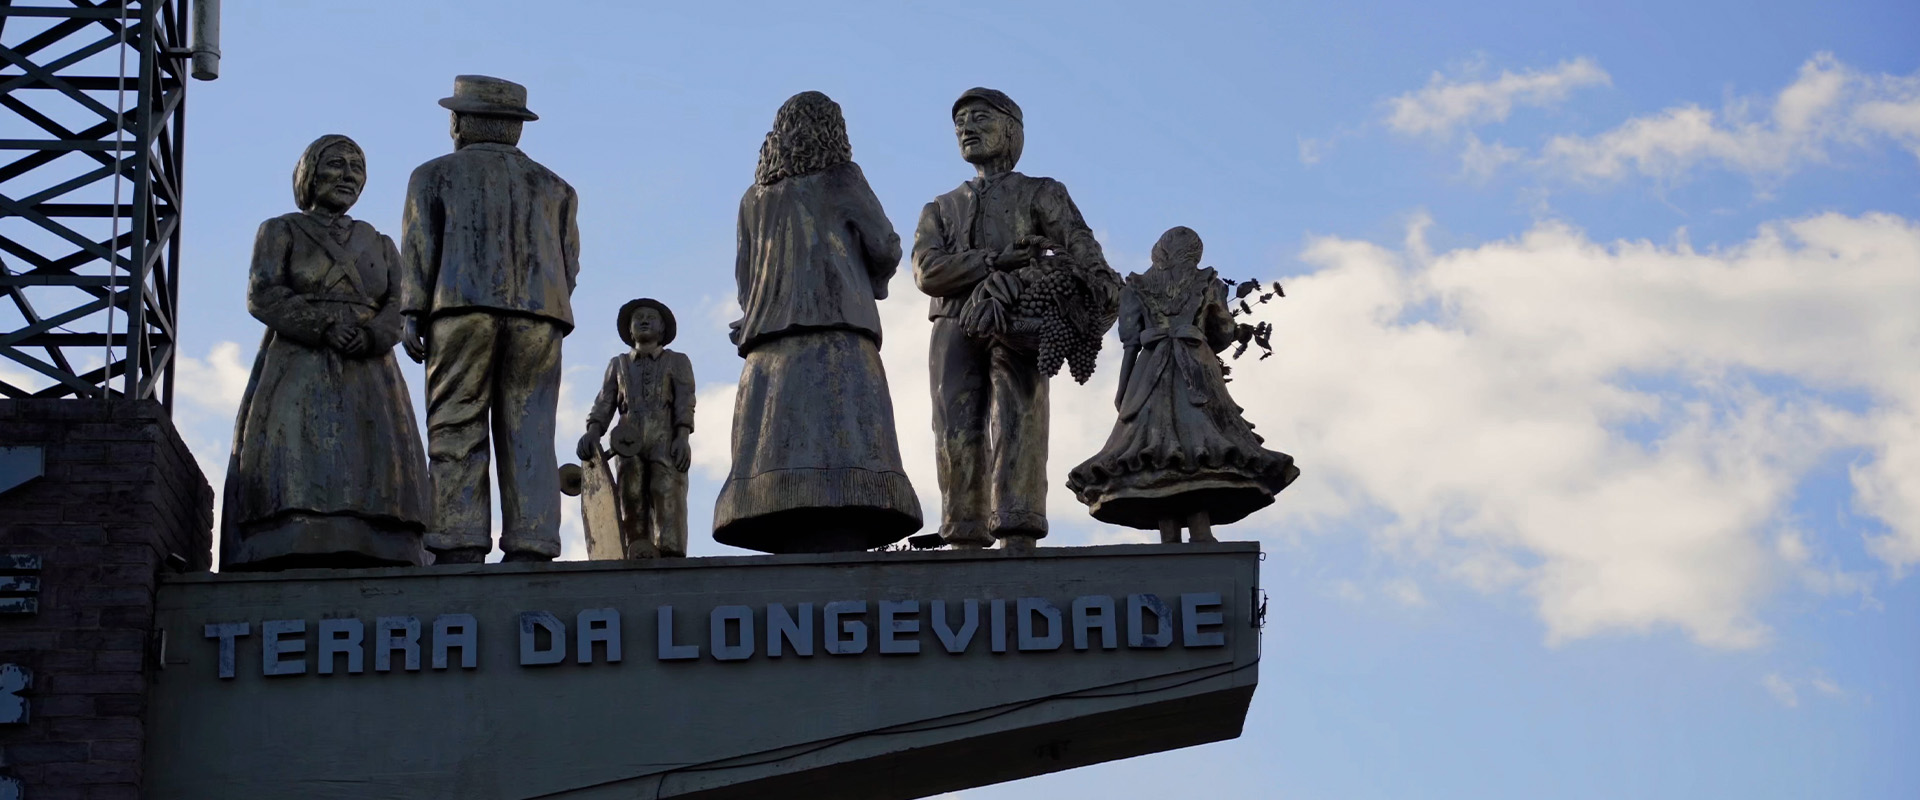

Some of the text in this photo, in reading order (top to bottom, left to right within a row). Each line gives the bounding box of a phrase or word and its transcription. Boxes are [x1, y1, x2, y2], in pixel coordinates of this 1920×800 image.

[204, 593, 1225, 678] TERRA DA LONGEVIDADE
